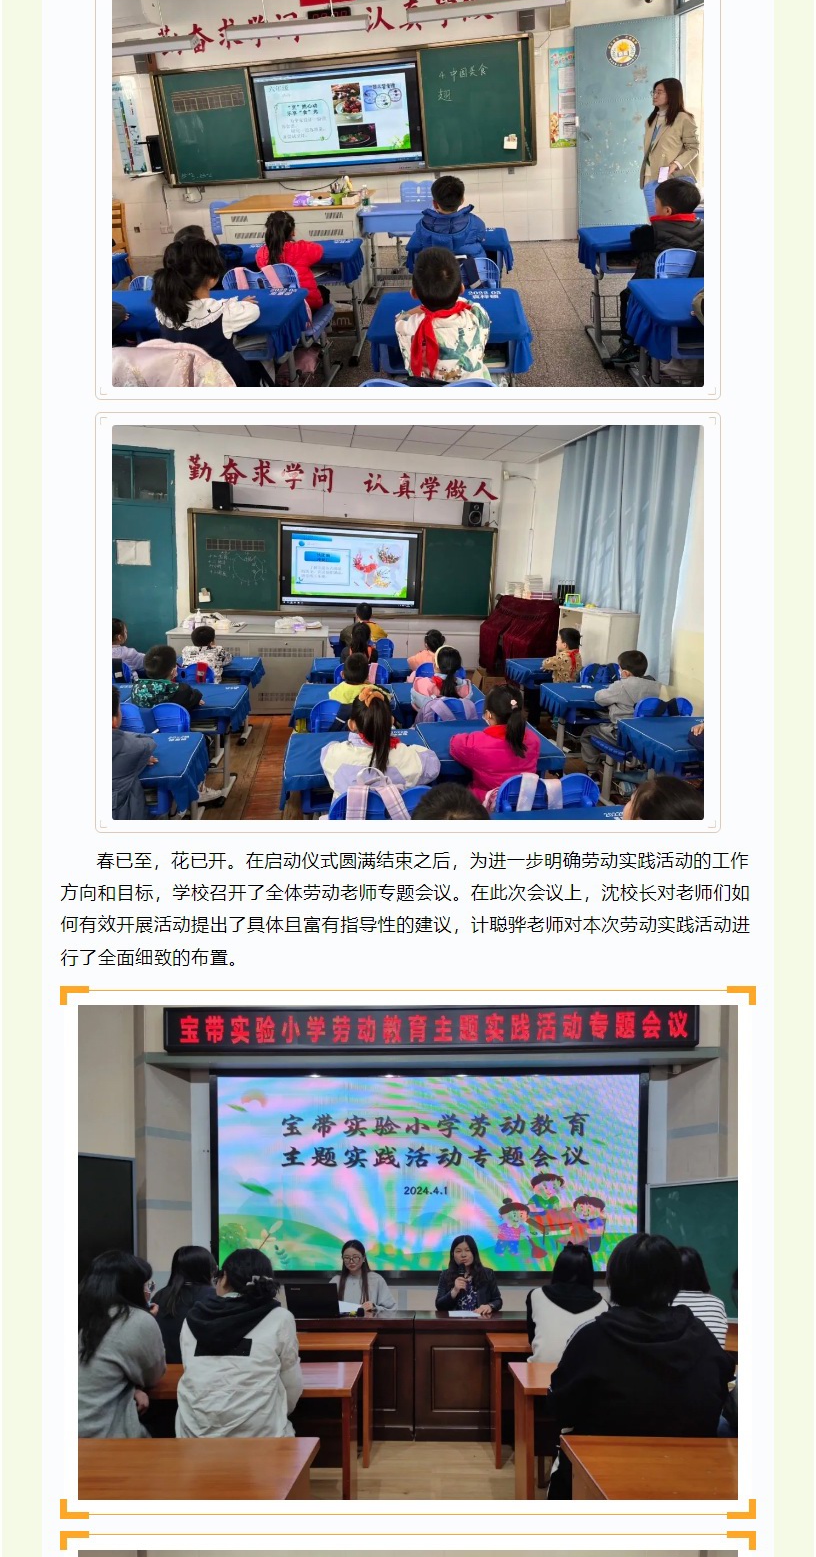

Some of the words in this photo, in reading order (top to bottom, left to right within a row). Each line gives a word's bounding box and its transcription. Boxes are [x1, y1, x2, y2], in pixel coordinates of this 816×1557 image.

[187, 454, 334, 493] 勤奋求学问
[363, 472, 499, 502] 认真学做人
[96, 850, 749, 871] 春已至，花已开。在启动仪式圆满结束之后，为进一步明确劳动实践活动的工作
[60, 882, 749, 903] 方向和目标，学校召开了全体劳动老师专题会议。在此次会议上，沈校长对老师们如
[60, 914, 750, 935] 何有效开展活动提出了具体且富有指导性的建议，计聪骅老师对本次劳动实践活动进
[60, 947, 237, 967] 行了全面细致的布置。
[179, 1010, 689, 1044] 宝带实验小学劳动教育主题实践活动专题会议
[280, 1111, 591, 1138] 宝带实验小学劳动教育
[281, 1144, 590, 1169] 主题实践活动专题会议
[403, 1185, 448, 1196] 2024.4.1
